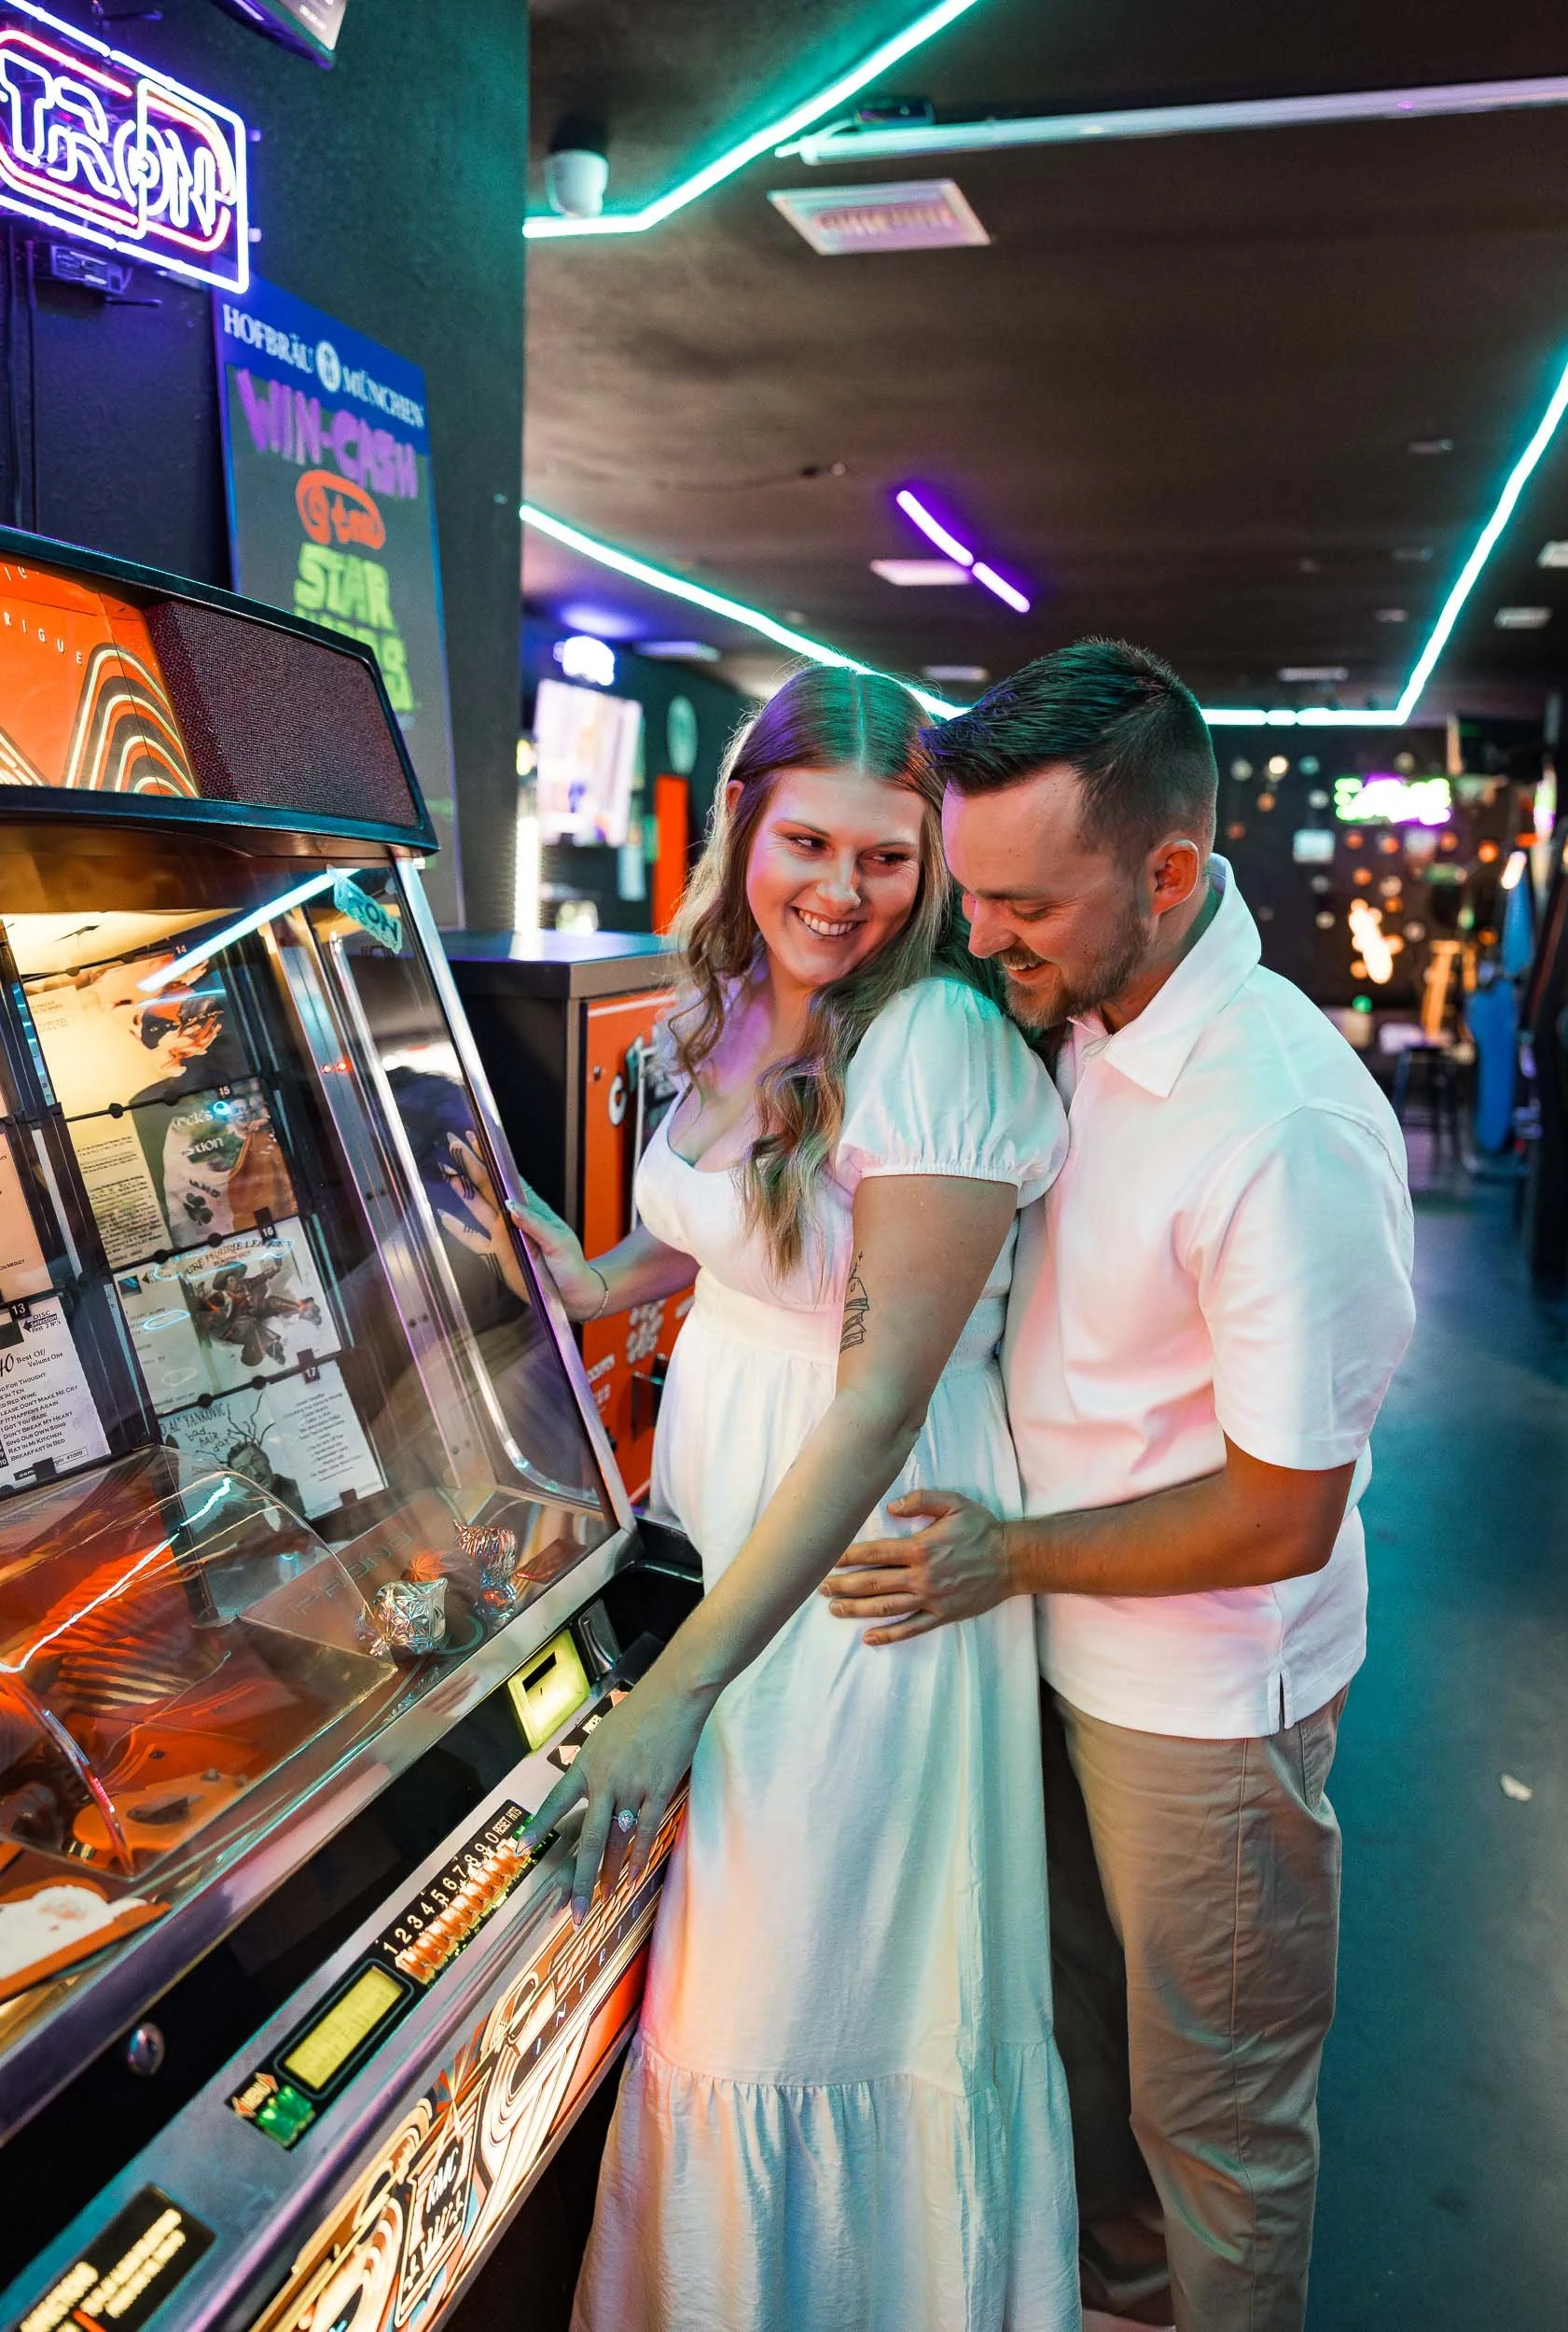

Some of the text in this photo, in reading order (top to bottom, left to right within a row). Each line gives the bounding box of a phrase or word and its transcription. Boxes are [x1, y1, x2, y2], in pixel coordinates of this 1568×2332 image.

[222, 303, 425, 429] HOFBRÄU MÜNCHEN
[293, 541, 398, 633] STAR
[218, 1086, 230, 1097] 15
[262, 1226, 274, 1238] 16
[11, 1303, 26, 1315] 13
[33, 1311, 51, 1320] DISC
[16, 1353, 33, 1364] Best
[27, 1352, 63, 1368] Volume One
[20, 1372, 46, 1385] THOUGHT
[306, 1367, 317, 1379] 17
[37, 1394, 56, 1403] MAKE
[11, 1407, 40, 1421] HAPPENS
[40, 1401, 59, 1409] AGAIN
[4, 1423, 17, 1431] GOT
[17, 1418, 31, 1426] YOU
[21, 1422, 43, 1433] BREAK
[52, 1411, 74, 1421] HEART
[34, 1427, 50, 1437] OWN
[50, 1423, 66, 1431] SONG
[36, 1432, 62, 1444] KITCHEN
[10, 1445, 47, 1462] BREAKFAST
[492, 1817, 512, 1836] RESET
[382, 1831, 500, 1955] 1 2 3 4 5 6 7 8 9 0
